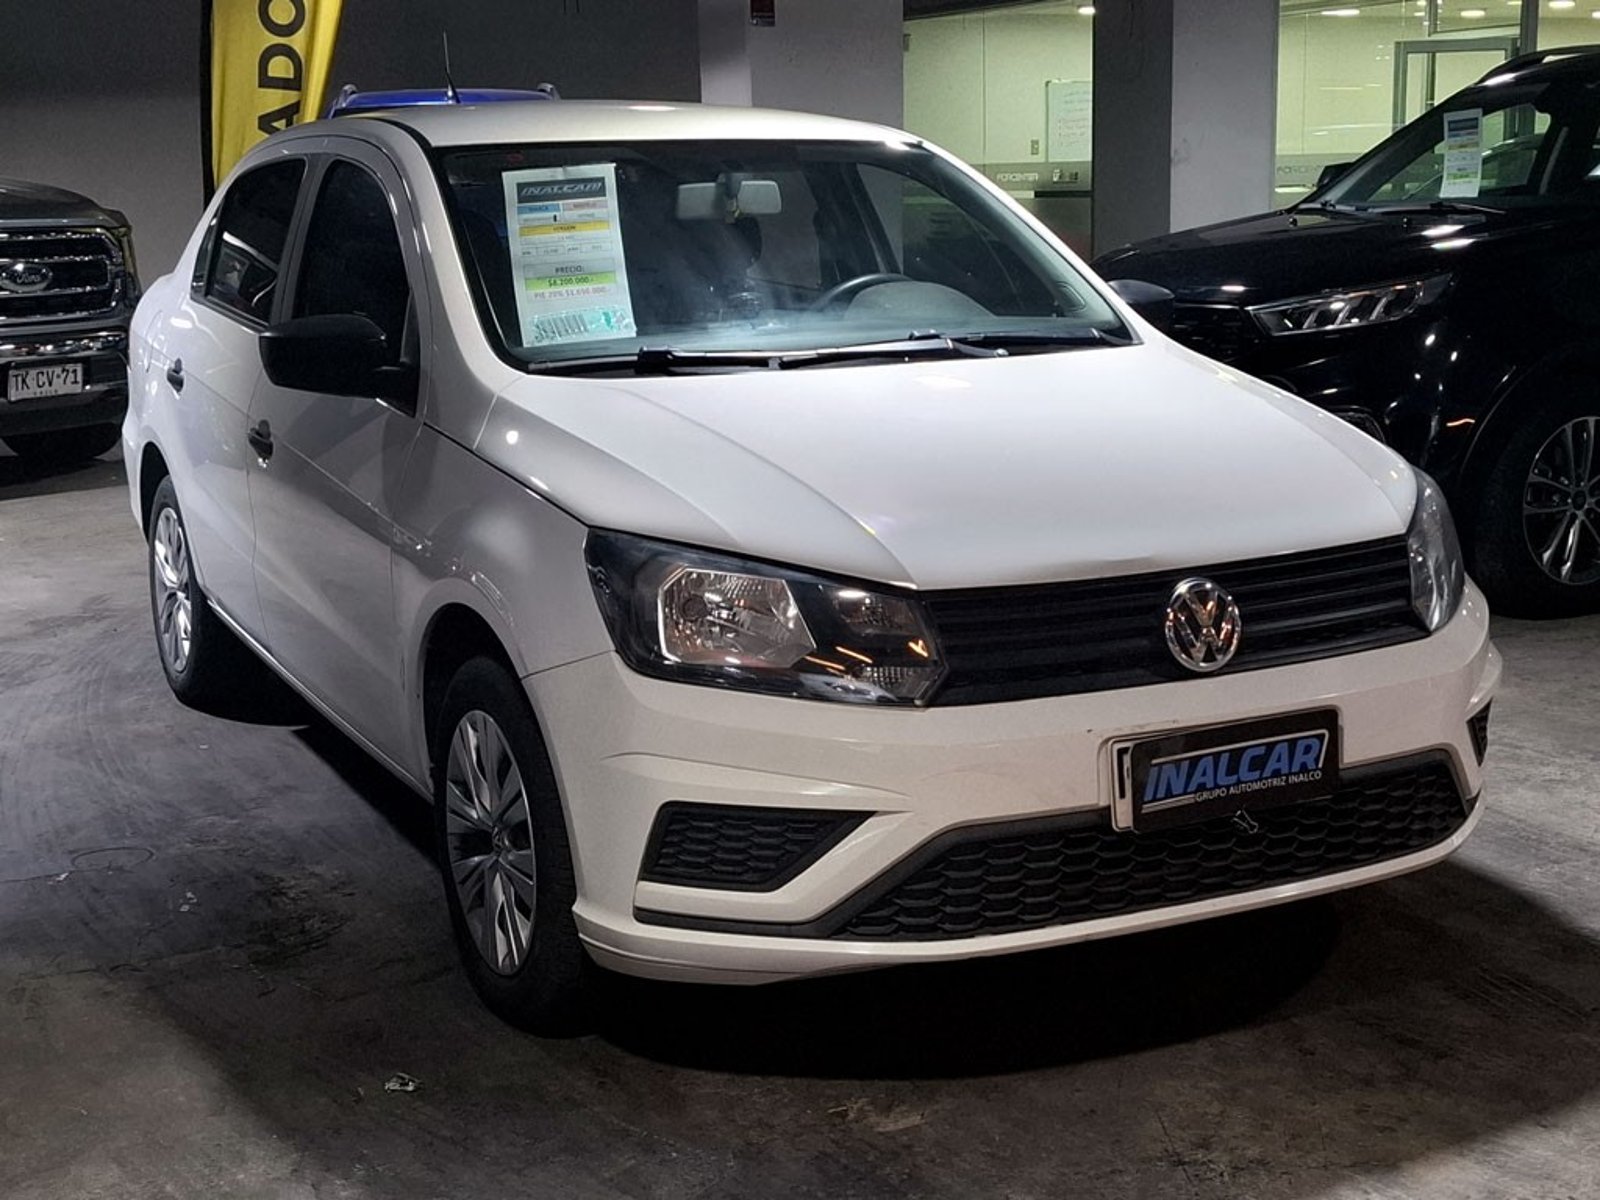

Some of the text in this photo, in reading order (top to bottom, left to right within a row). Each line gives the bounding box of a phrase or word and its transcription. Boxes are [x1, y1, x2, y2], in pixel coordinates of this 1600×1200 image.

[521, 182, 602, 196] INALCAR
[1143, 737, 1321, 801] INALCAR
[1196, 770, 1322, 801] GRUPO AUTOMOTRIZ INALCO
